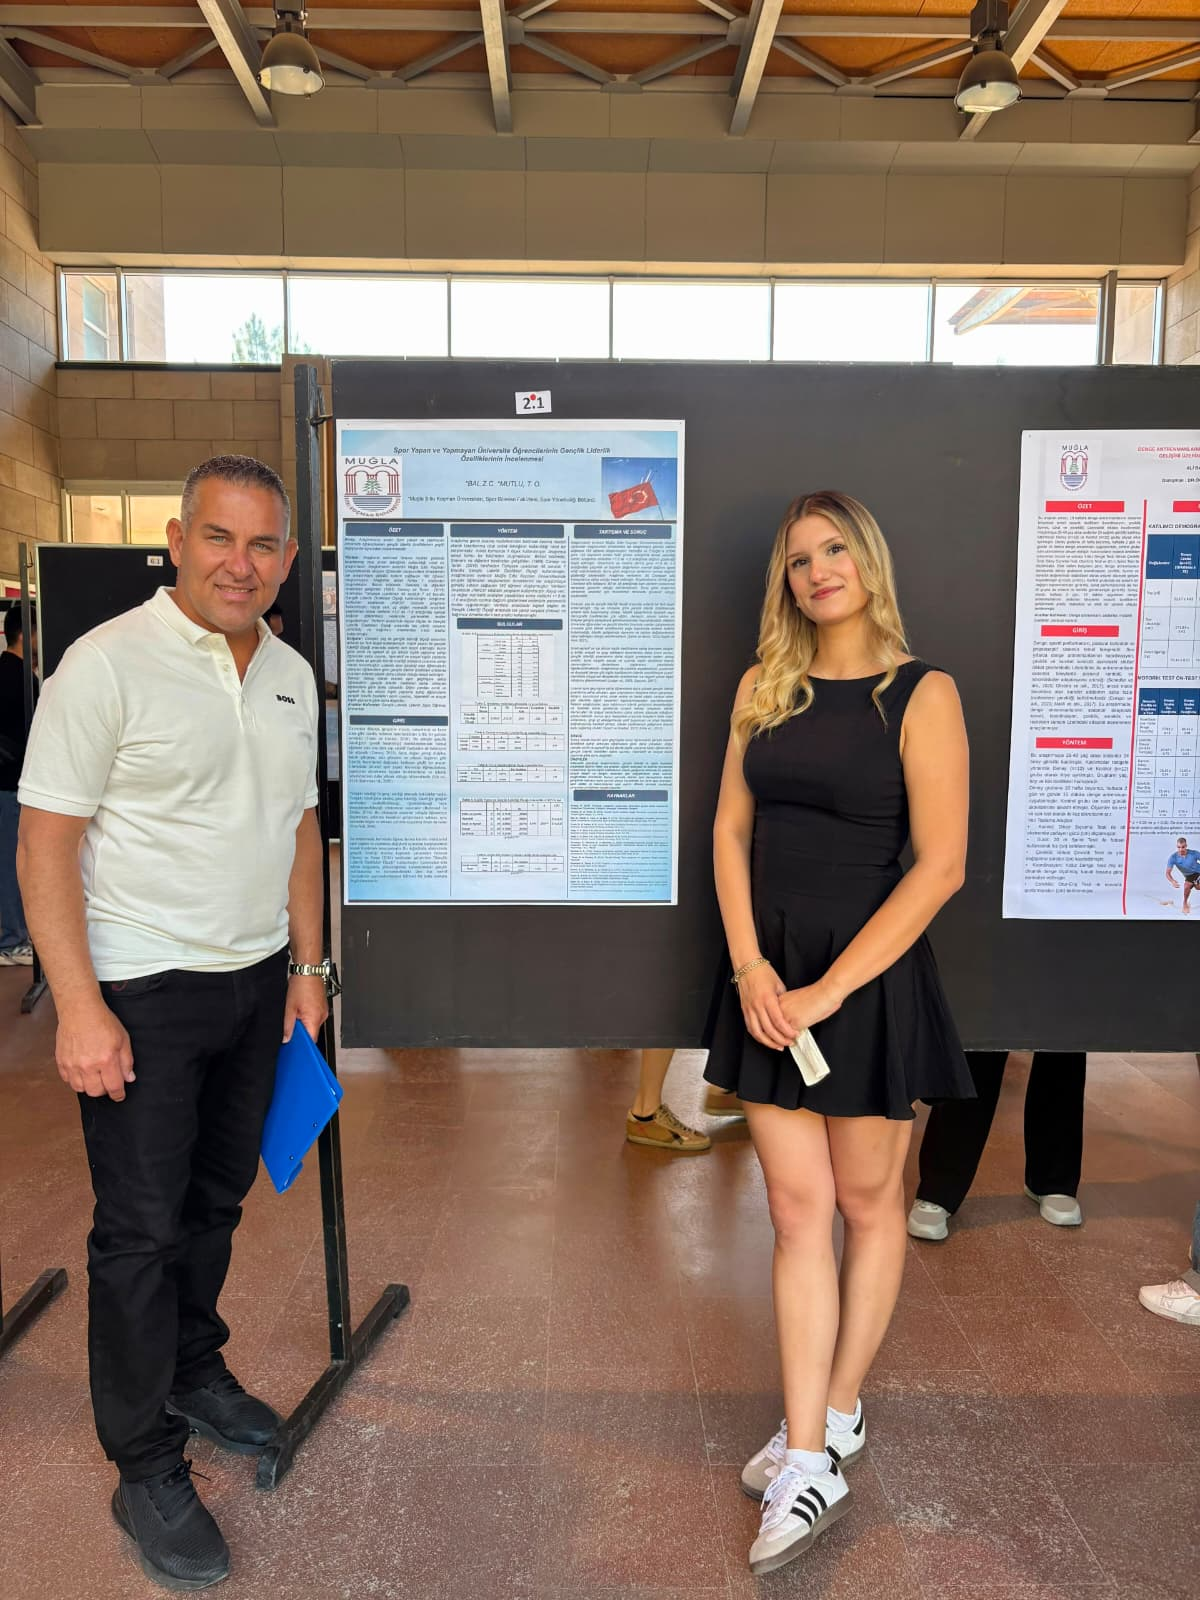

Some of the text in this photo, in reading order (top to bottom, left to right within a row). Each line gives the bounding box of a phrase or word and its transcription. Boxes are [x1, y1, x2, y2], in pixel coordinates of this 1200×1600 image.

[523, 396, 545, 410] 2.1
[393, 447, 409, 455] Spor
[442, 447, 476, 455] Yapmayan
[345, 456, 399, 465] MUĞLA
[275, 694, 296, 705] BOSS
